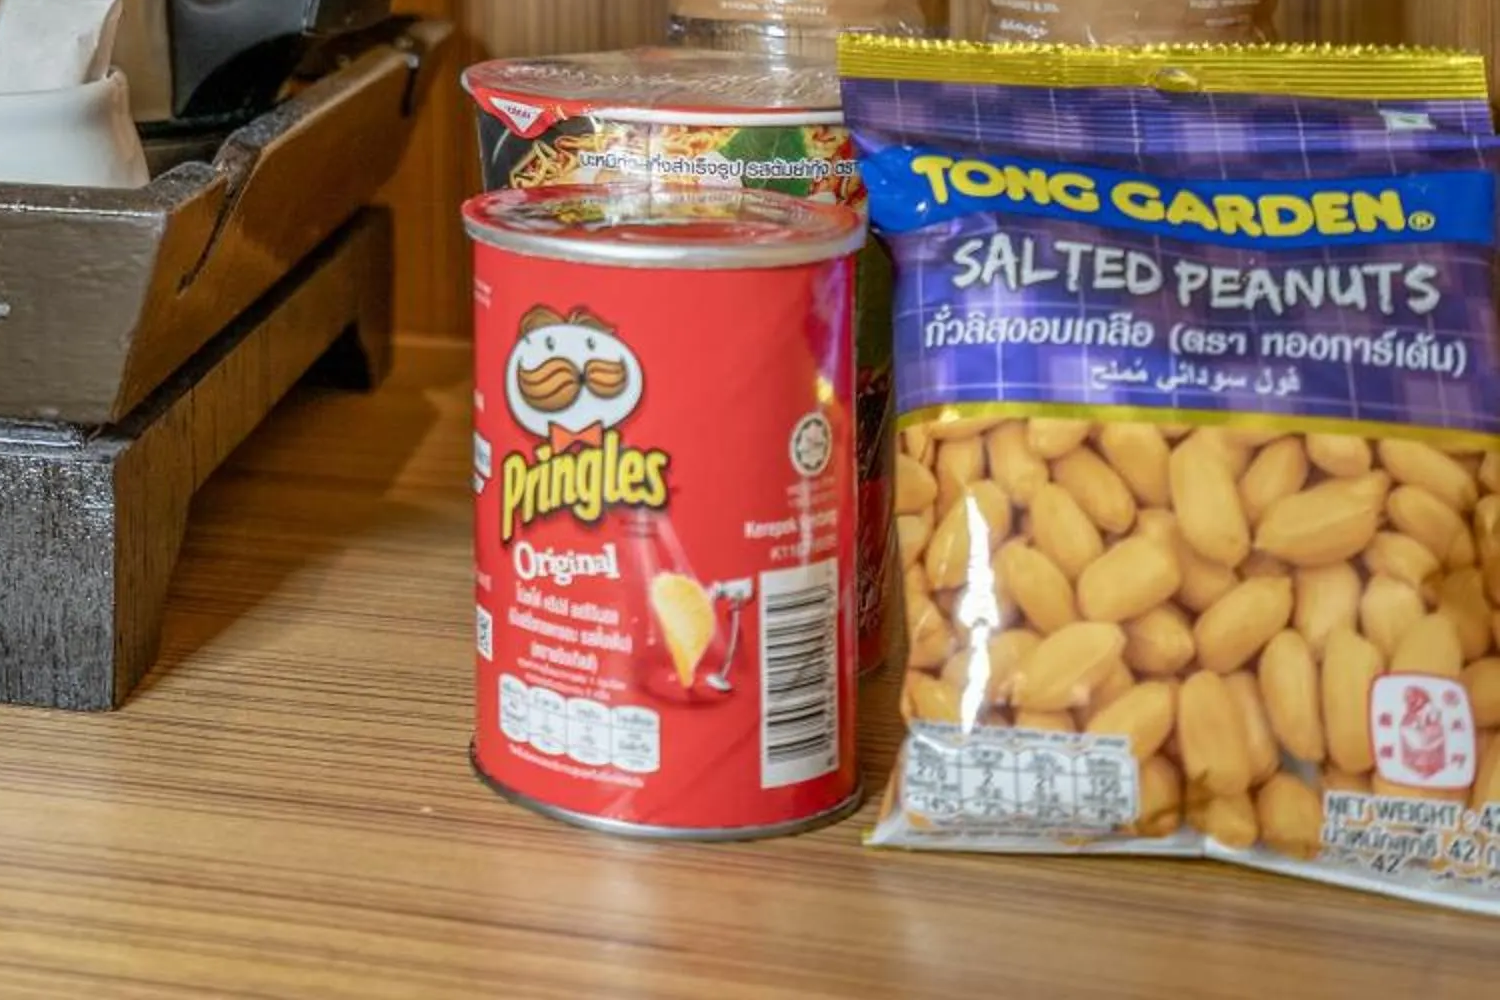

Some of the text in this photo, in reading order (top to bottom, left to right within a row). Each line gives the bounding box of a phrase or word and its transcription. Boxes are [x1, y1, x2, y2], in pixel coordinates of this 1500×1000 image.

[911, 155, 1406, 236] TONG GARDEN
[952, 233, 1441, 315] SALTED PEANUTS
[925, 304, 1155, 348] ถั่วลิสงอบเกลือ
[502, 432, 670, 541] Pringles
[514, 540, 621, 586] Original
[1327, 797, 1365, 819] NET
[1375, 801, 1458, 828] WEIGHT
[1449, 837, 1476, 863] 42
